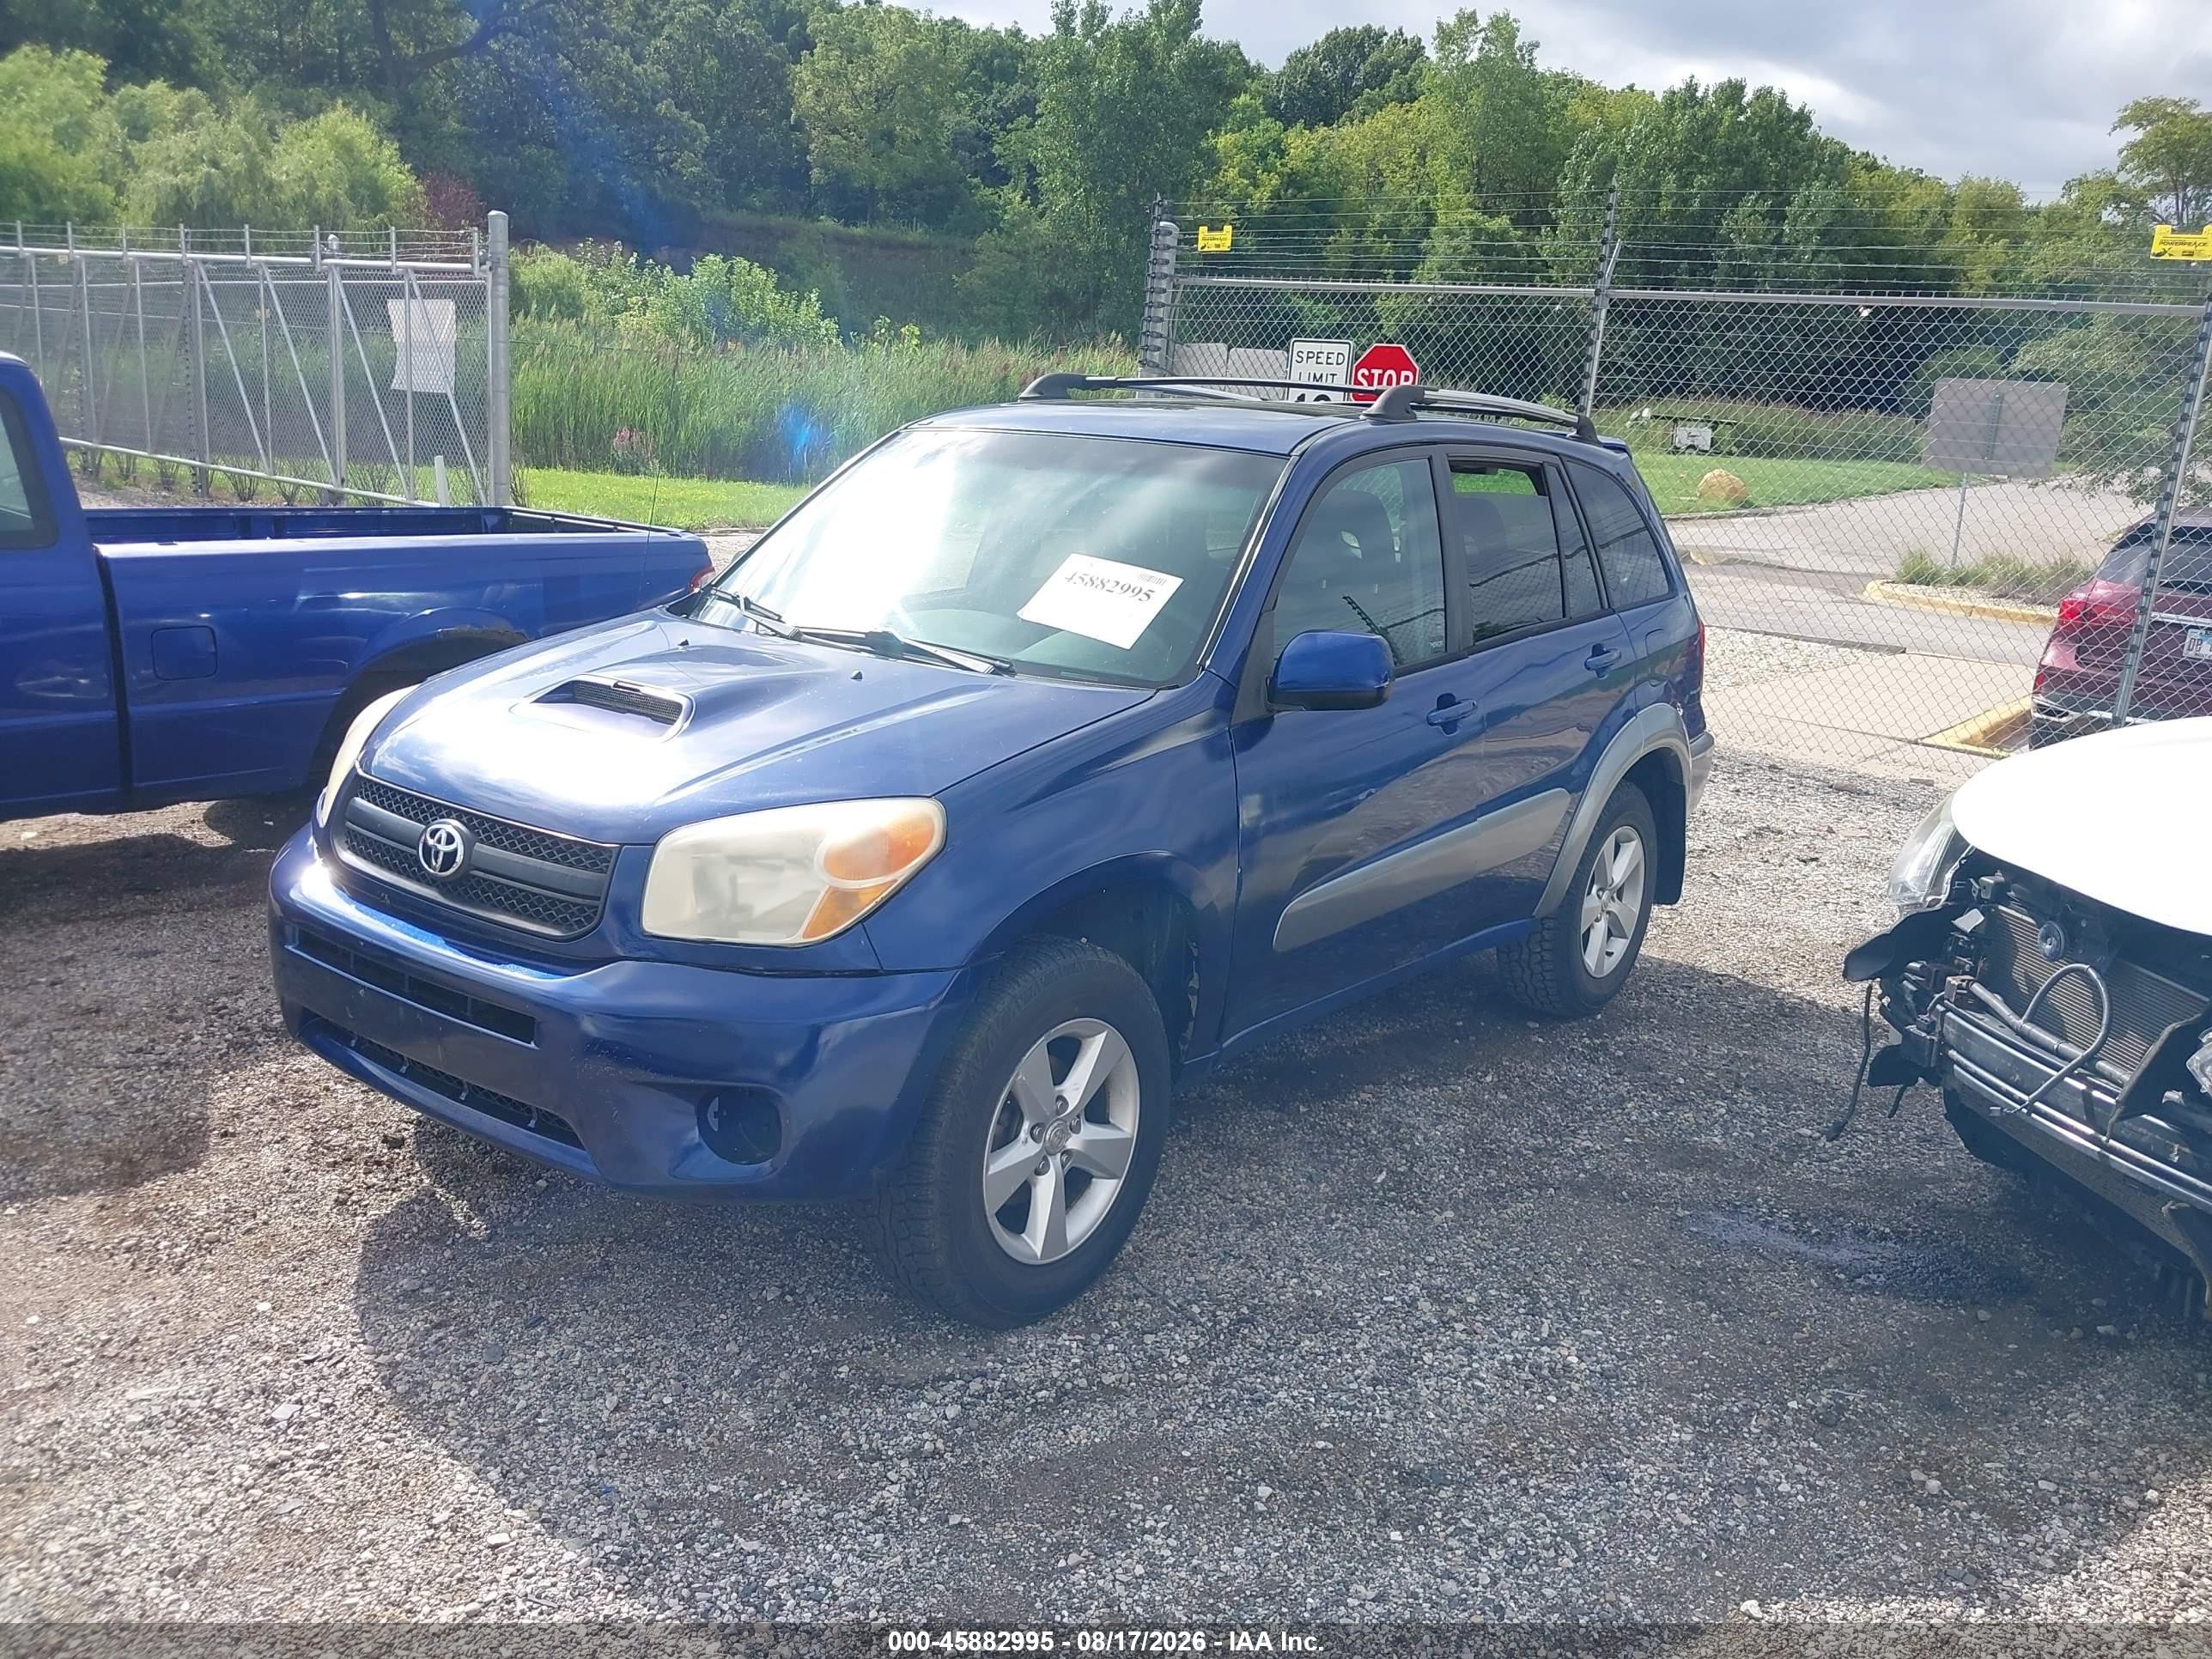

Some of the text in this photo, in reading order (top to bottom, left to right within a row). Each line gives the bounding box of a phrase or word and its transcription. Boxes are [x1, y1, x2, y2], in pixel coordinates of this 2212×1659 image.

[1295, 350, 1346, 366] SPEED
[1357, 368, 1414, 392] STOP
[1064, 571, 1156, 602] 45882995
